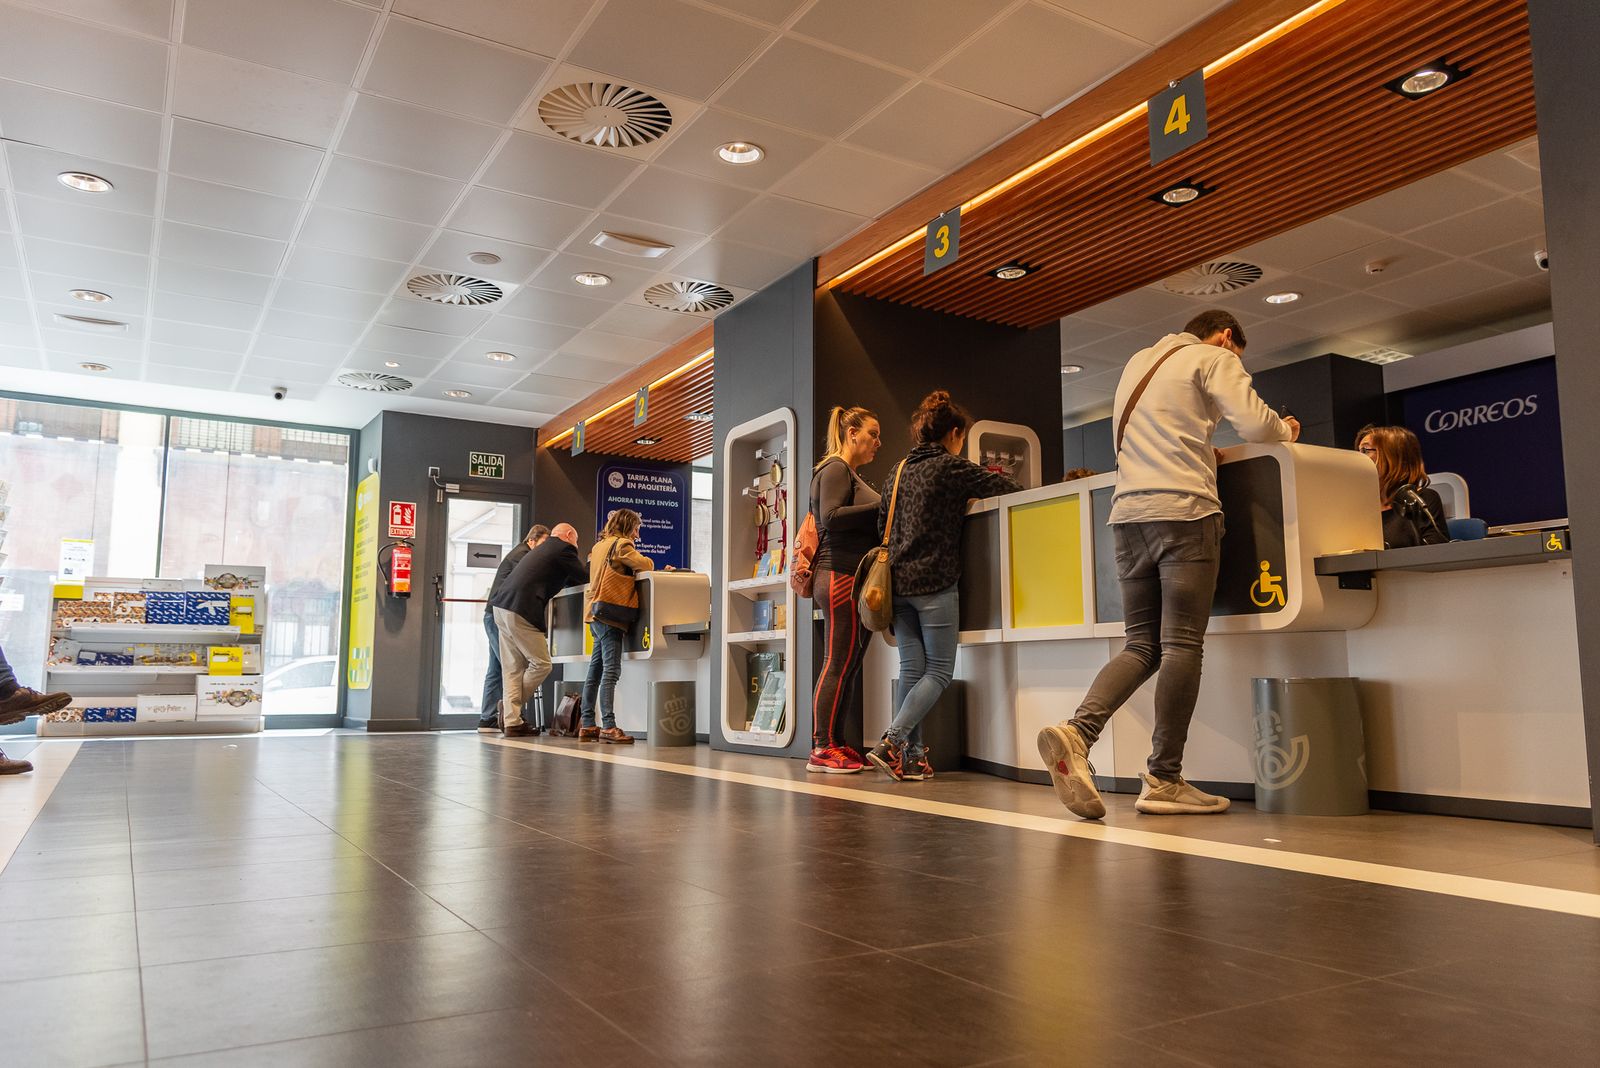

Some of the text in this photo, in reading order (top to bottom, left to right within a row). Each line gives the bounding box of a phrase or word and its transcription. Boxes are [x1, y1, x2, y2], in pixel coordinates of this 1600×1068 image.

[1163, 94, 1191, 136] 4
[933, 225, 951, 259] 3
[638, 396, 645, 418] 2
[1424, 394, 1538, 433] CORREOS
[576, 430, 581, 449] 1
[471, 454, 503, 467] SALIDA
[477, 465, 497, 477] EXIT
[627, 474, 673, 484] TARIFA PLANA
[638, 483, 677, 493] PAQUETERÍA
[657, 500, 679, 508] ENVÍOS
[390, 526, 415, 536] EXTINTOR
